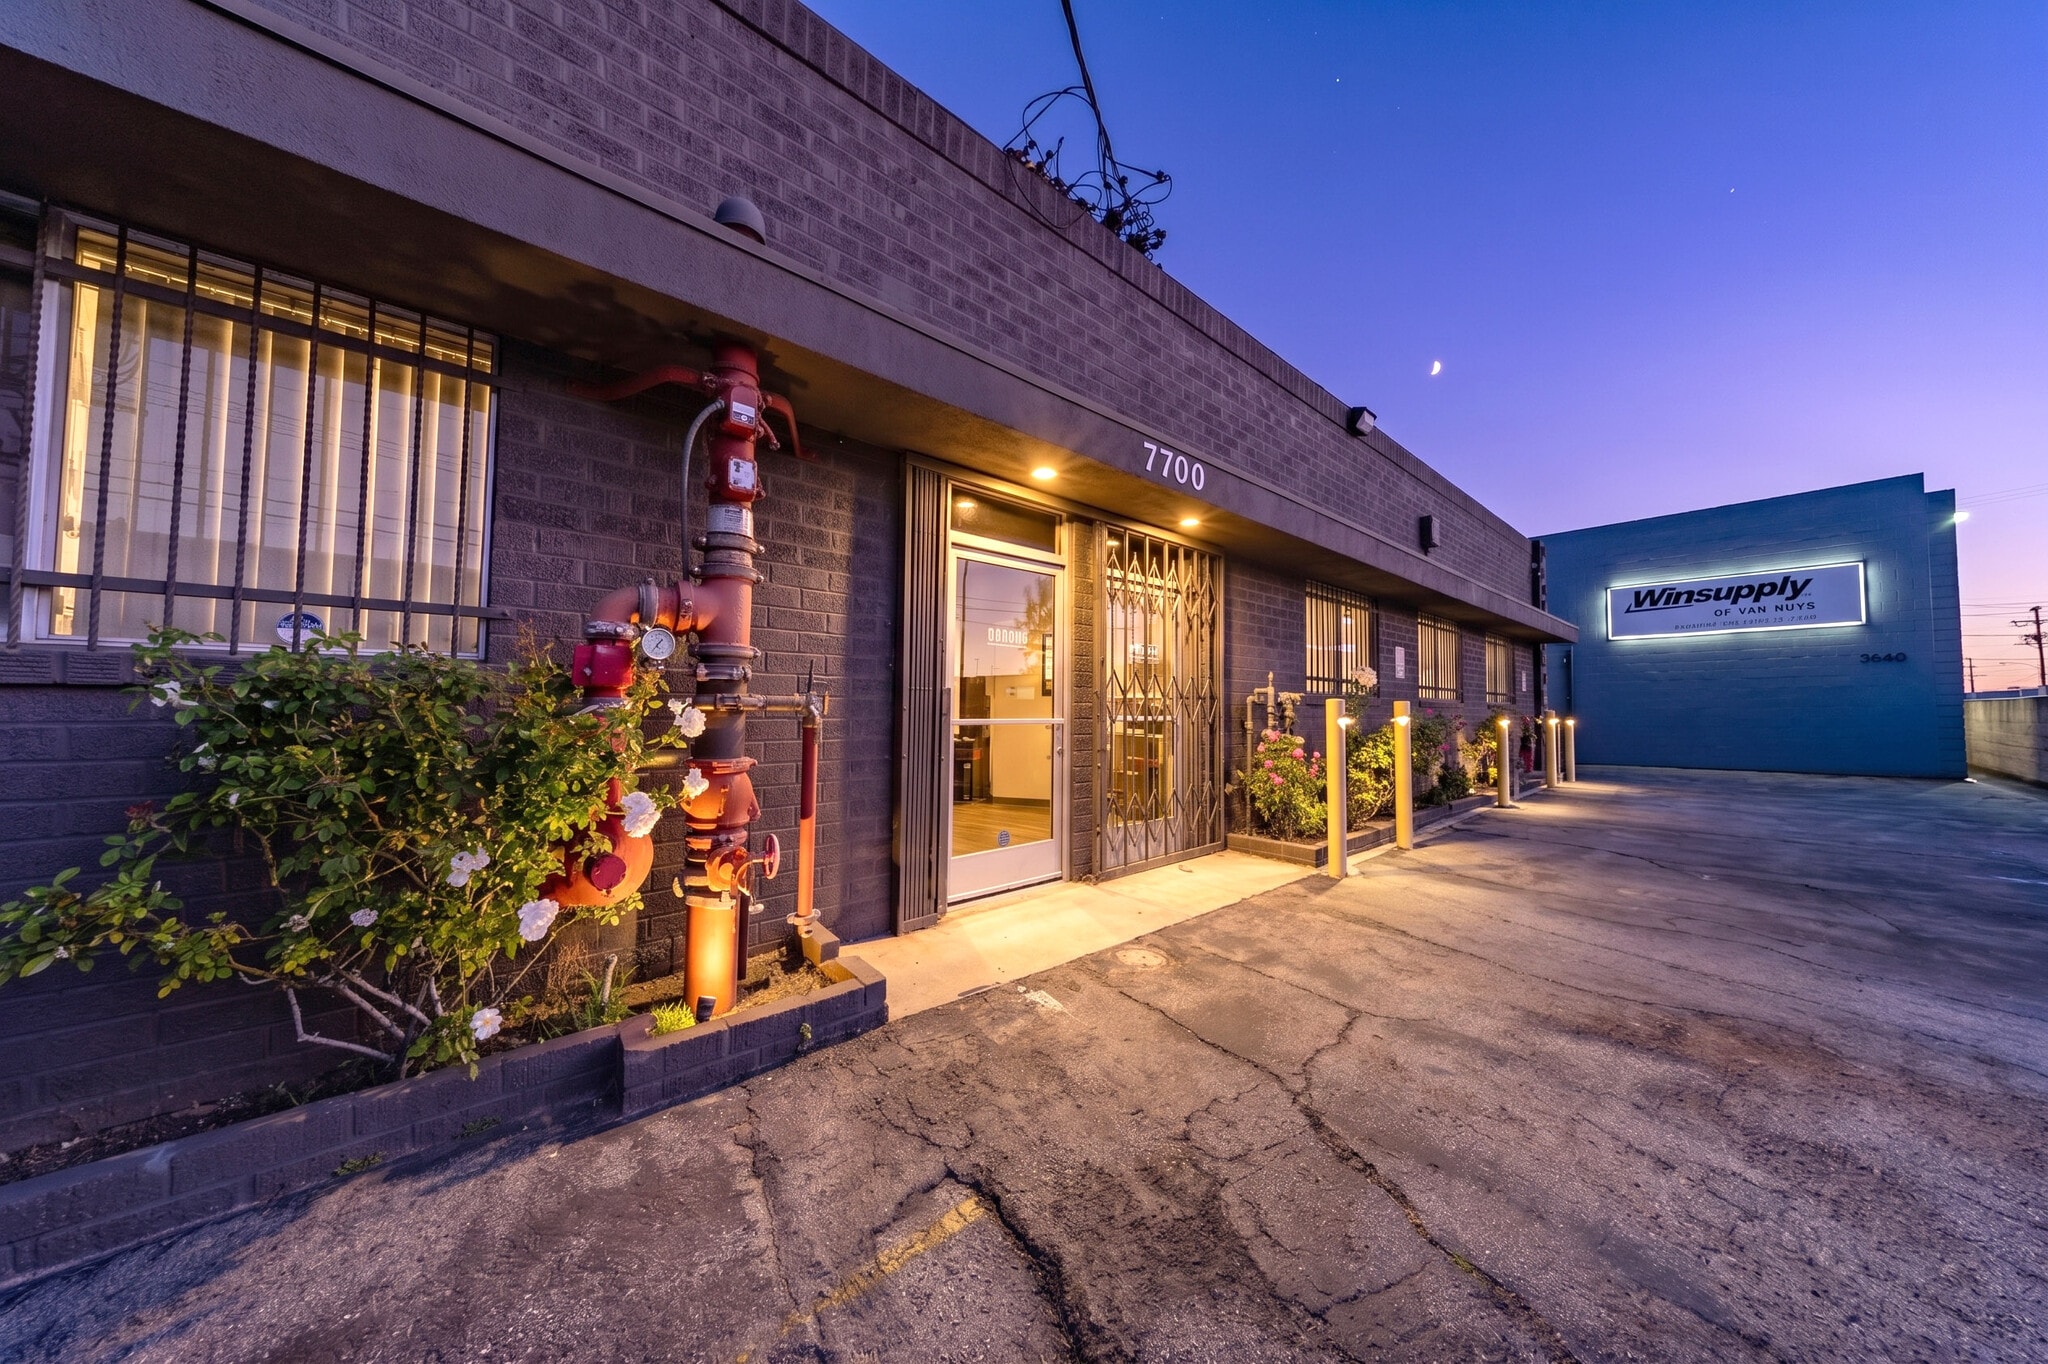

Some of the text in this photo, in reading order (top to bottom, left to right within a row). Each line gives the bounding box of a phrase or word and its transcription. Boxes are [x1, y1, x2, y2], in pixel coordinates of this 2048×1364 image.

[1143, 441, 1205, 491] 7700
[1633, 575, 1814, 609] Winsupply
[1713, 601, 1816, 617] OF VAN NUYS
[1860, 652, 1907, 664] 3640
